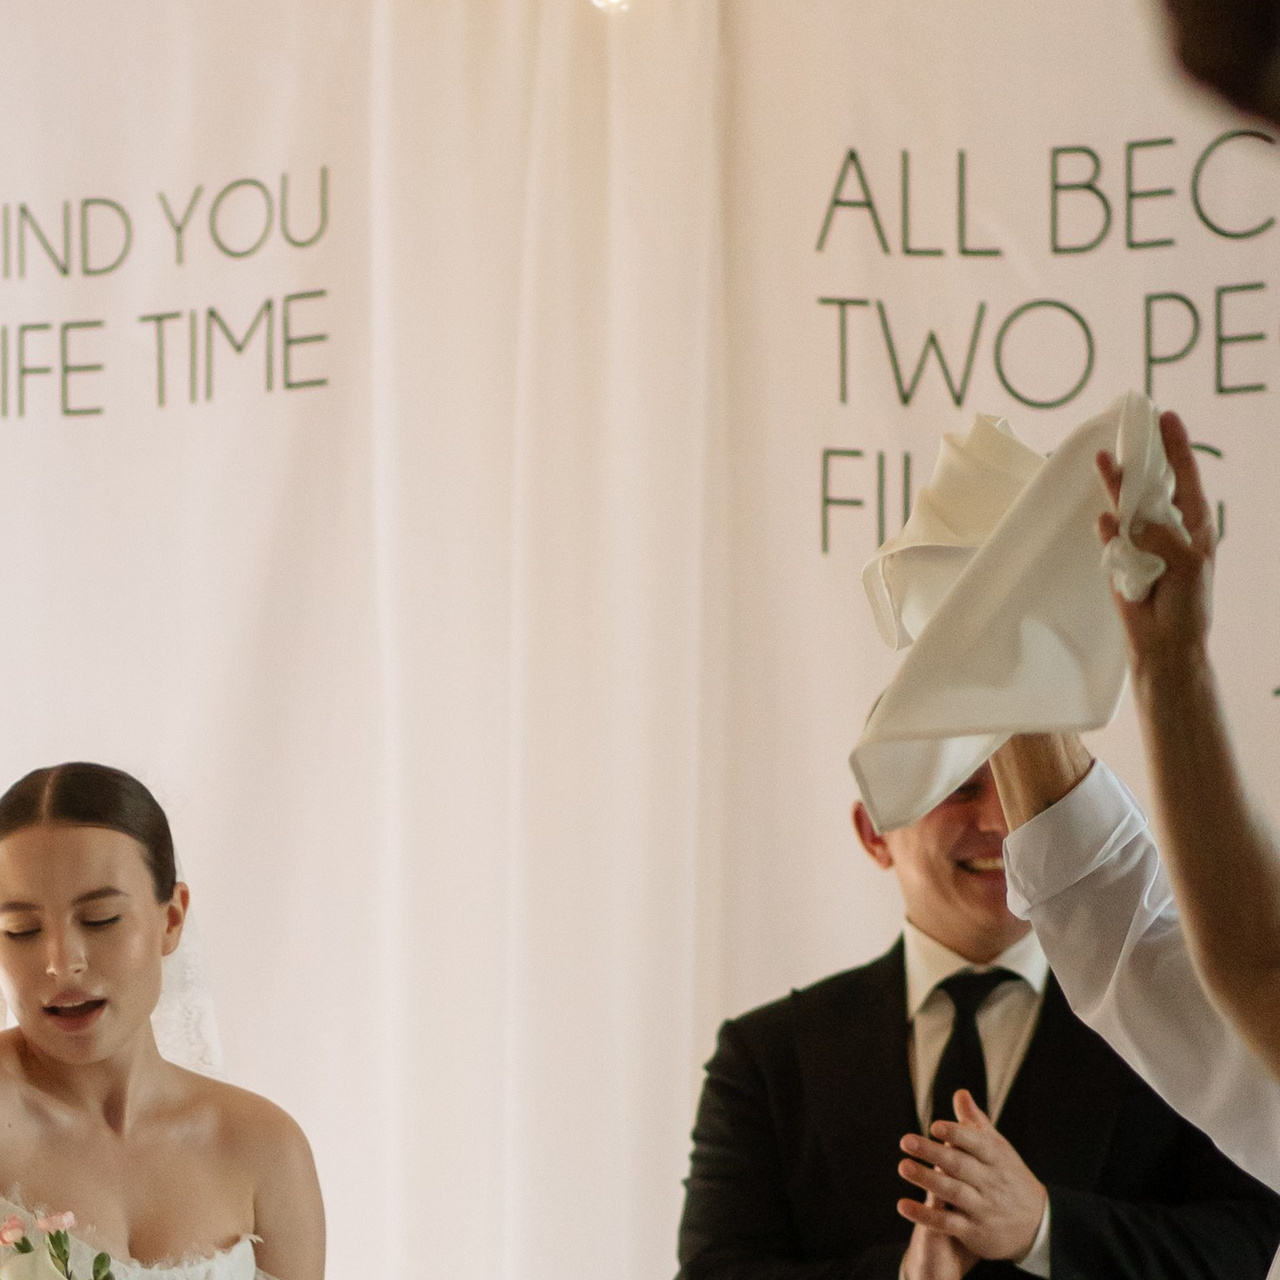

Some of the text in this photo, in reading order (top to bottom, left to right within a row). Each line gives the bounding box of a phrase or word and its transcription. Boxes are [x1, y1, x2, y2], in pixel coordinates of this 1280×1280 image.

[158, 164, 331, 266] YOU
[815, 144, 1005, 259] ALL
[137, 287, 331, 410] TIME
[816, 295, 1098, 410] TWO
